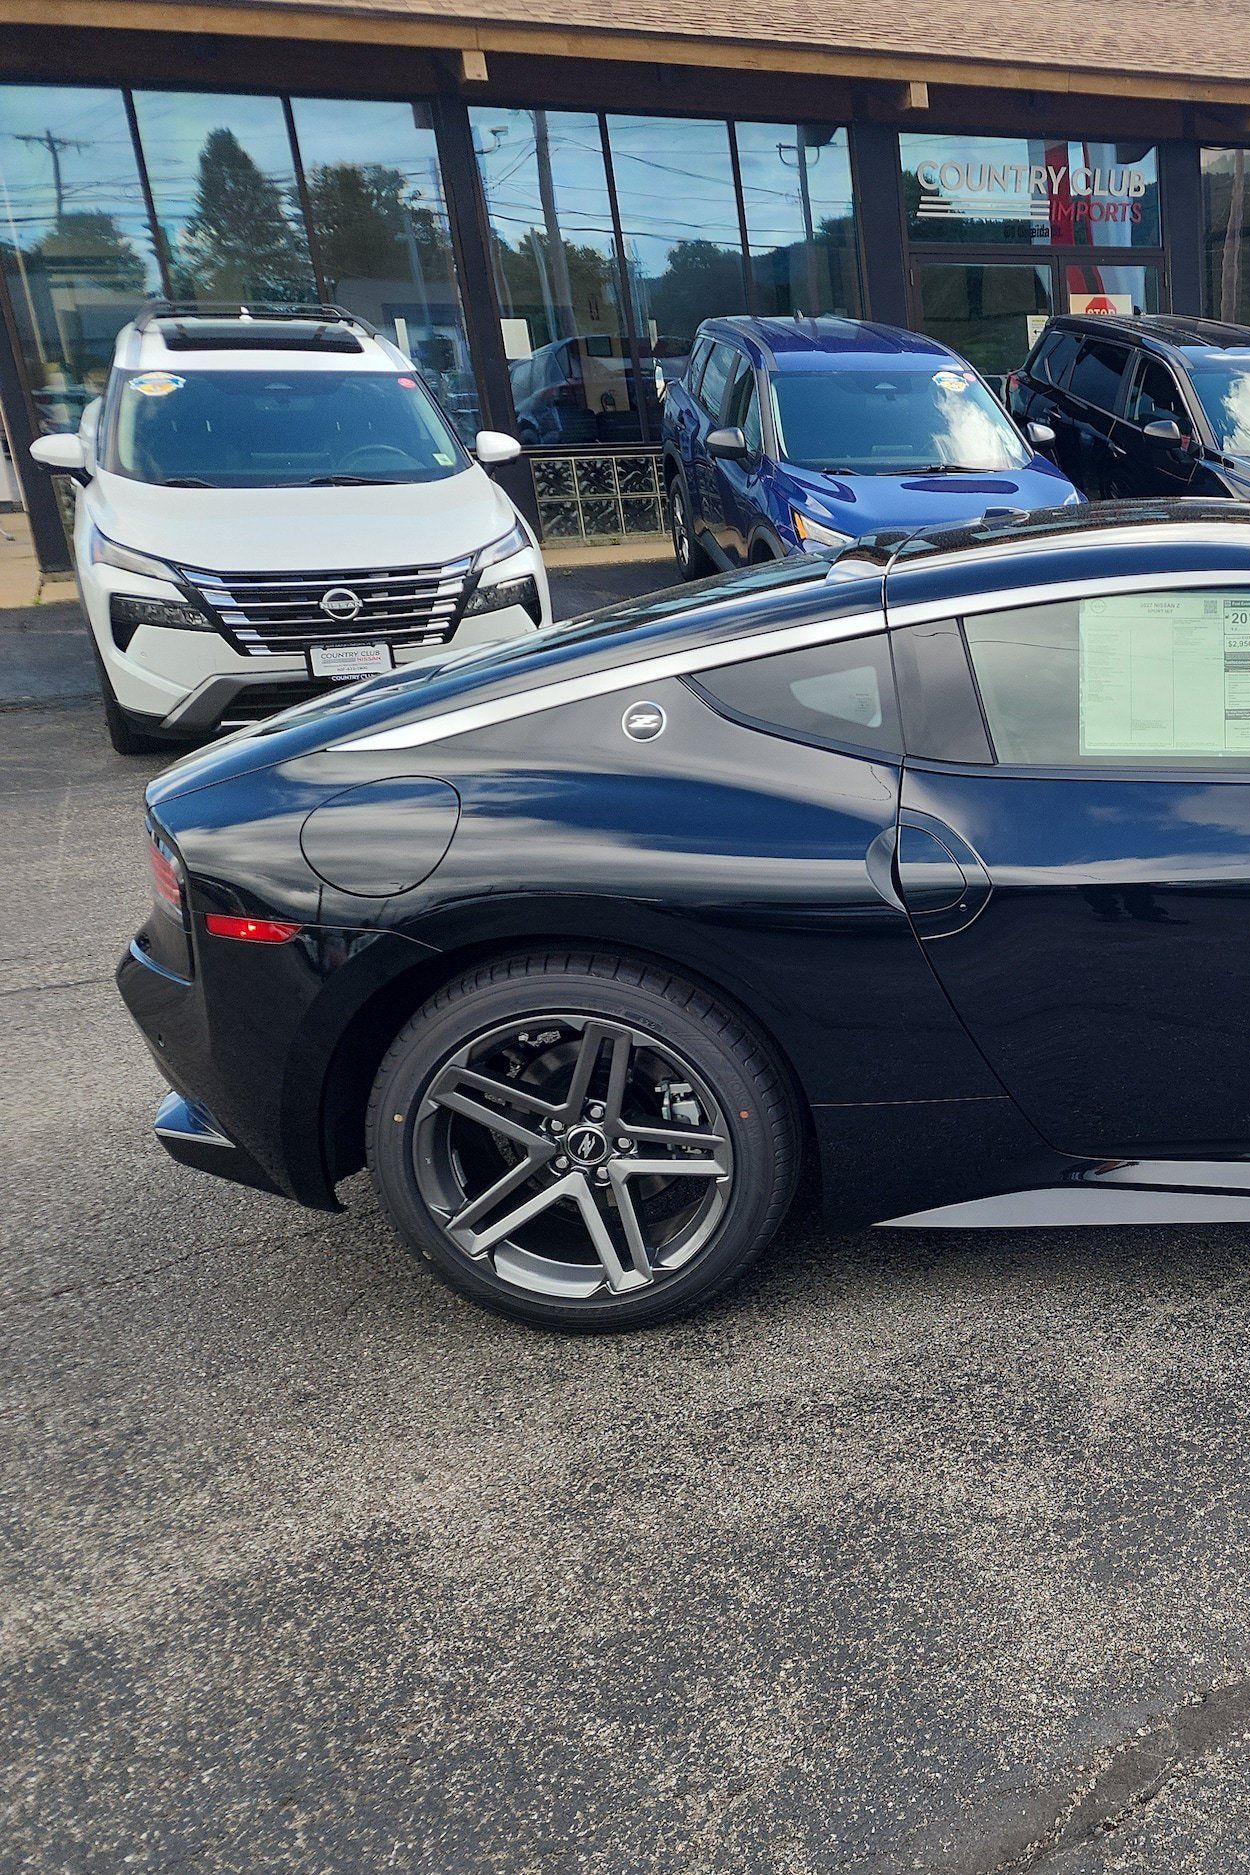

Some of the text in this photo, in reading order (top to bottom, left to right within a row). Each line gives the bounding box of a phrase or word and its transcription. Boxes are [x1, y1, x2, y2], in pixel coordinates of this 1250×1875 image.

[916, 160, 1146, 197] COUNTRY CLUB
[1052, 200, 1142, 224] IMPORTS
[320, 600, 363, 609] NISSAN
[1231, 612, 1248, 624] 20
[320, 649, 381, 660] COUNTRY CLUB
[331, 674, 360, 682] COUNTRY
[628, 714, 660, 728] Z
